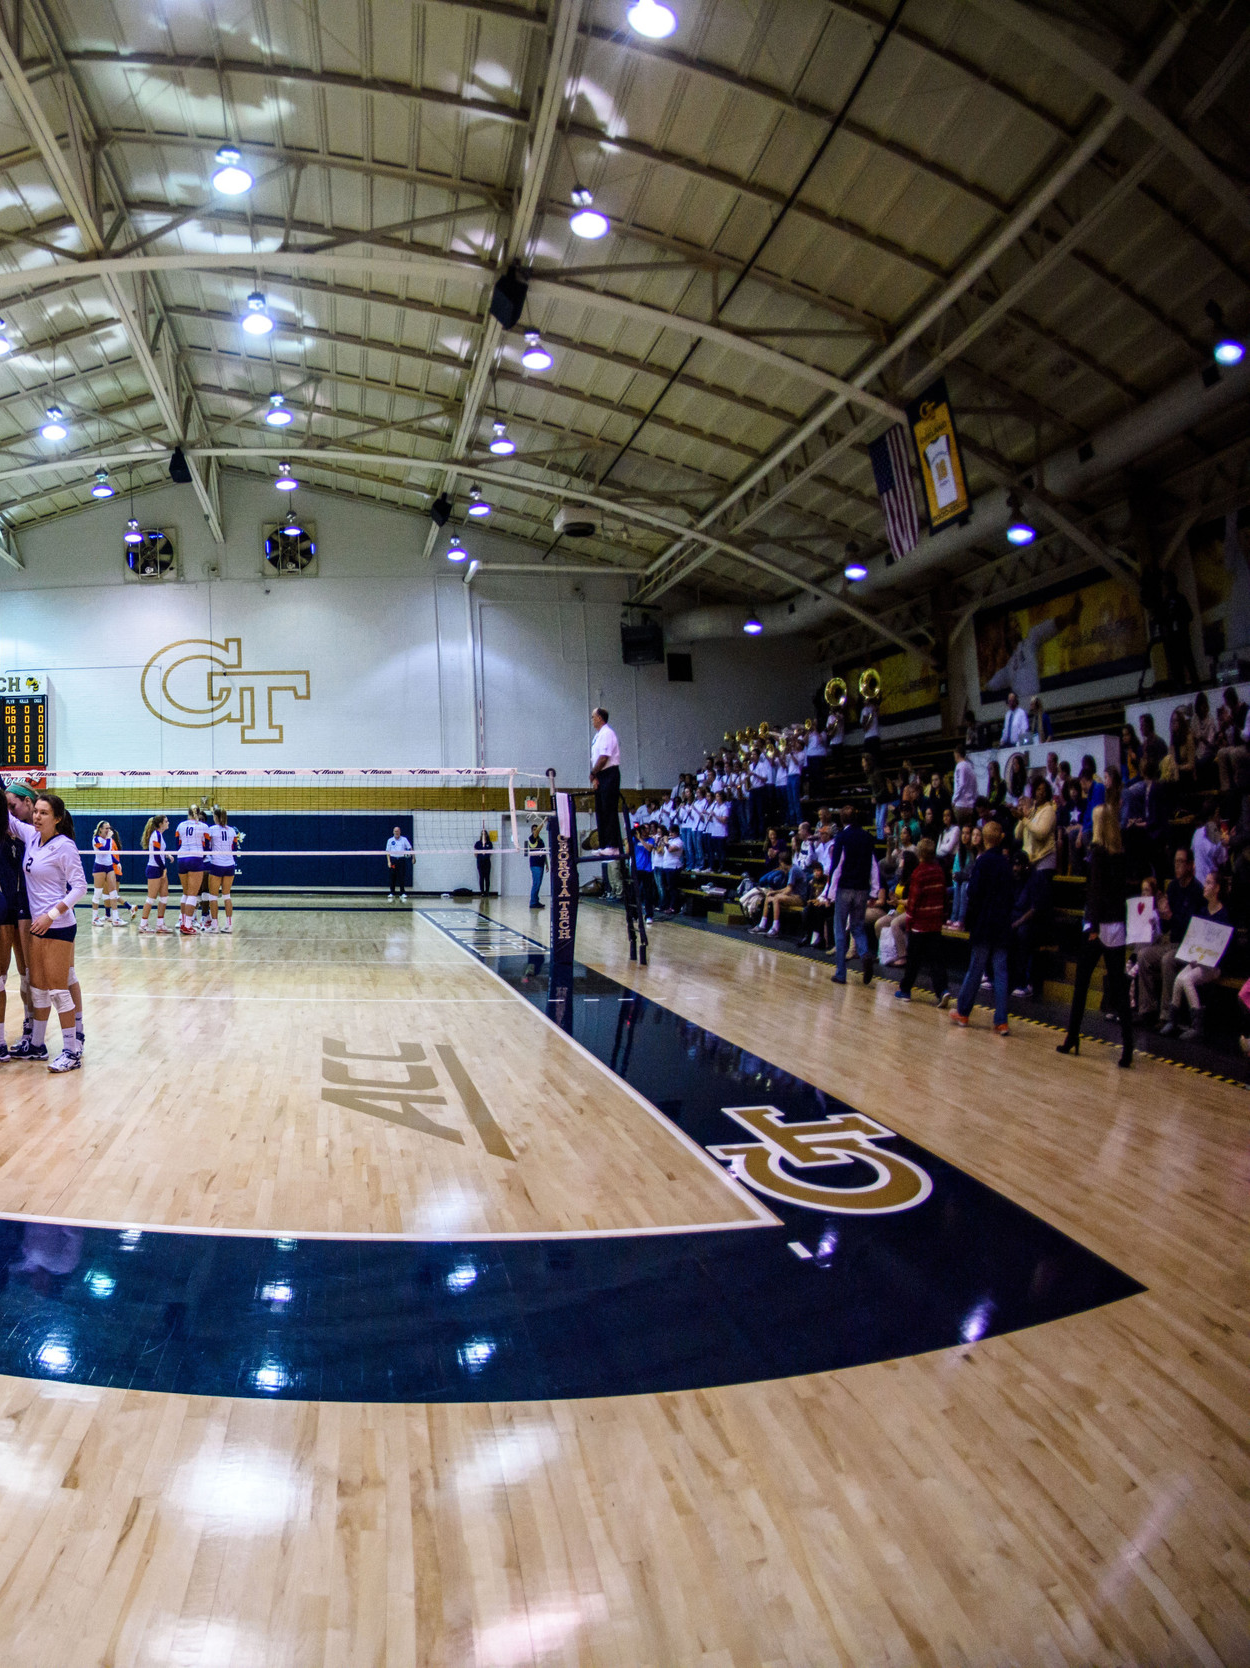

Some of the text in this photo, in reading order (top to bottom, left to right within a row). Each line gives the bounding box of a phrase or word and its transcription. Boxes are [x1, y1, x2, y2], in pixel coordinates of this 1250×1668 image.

[141, 638, 310, 744] GT
[5, 706, 17, 714] 06
[5, 716, 17, 724] 08
[8, 725, 17, 734] 10
[8, 735, 17, 743] 11
[8, 744, 17, 753] 12
[8, 754, 17, 763] 17
[185, 826, 194, 837] 10
[221, 831, 228, 841] 11
[25, 857, 34, 873] 2
[557, 834, 571, 897] GEORGIA
[558, 901, 571, 939] TECH
[321, 1037, 466, 1145] ACC
[705, 1105, 935, 1214] GT
